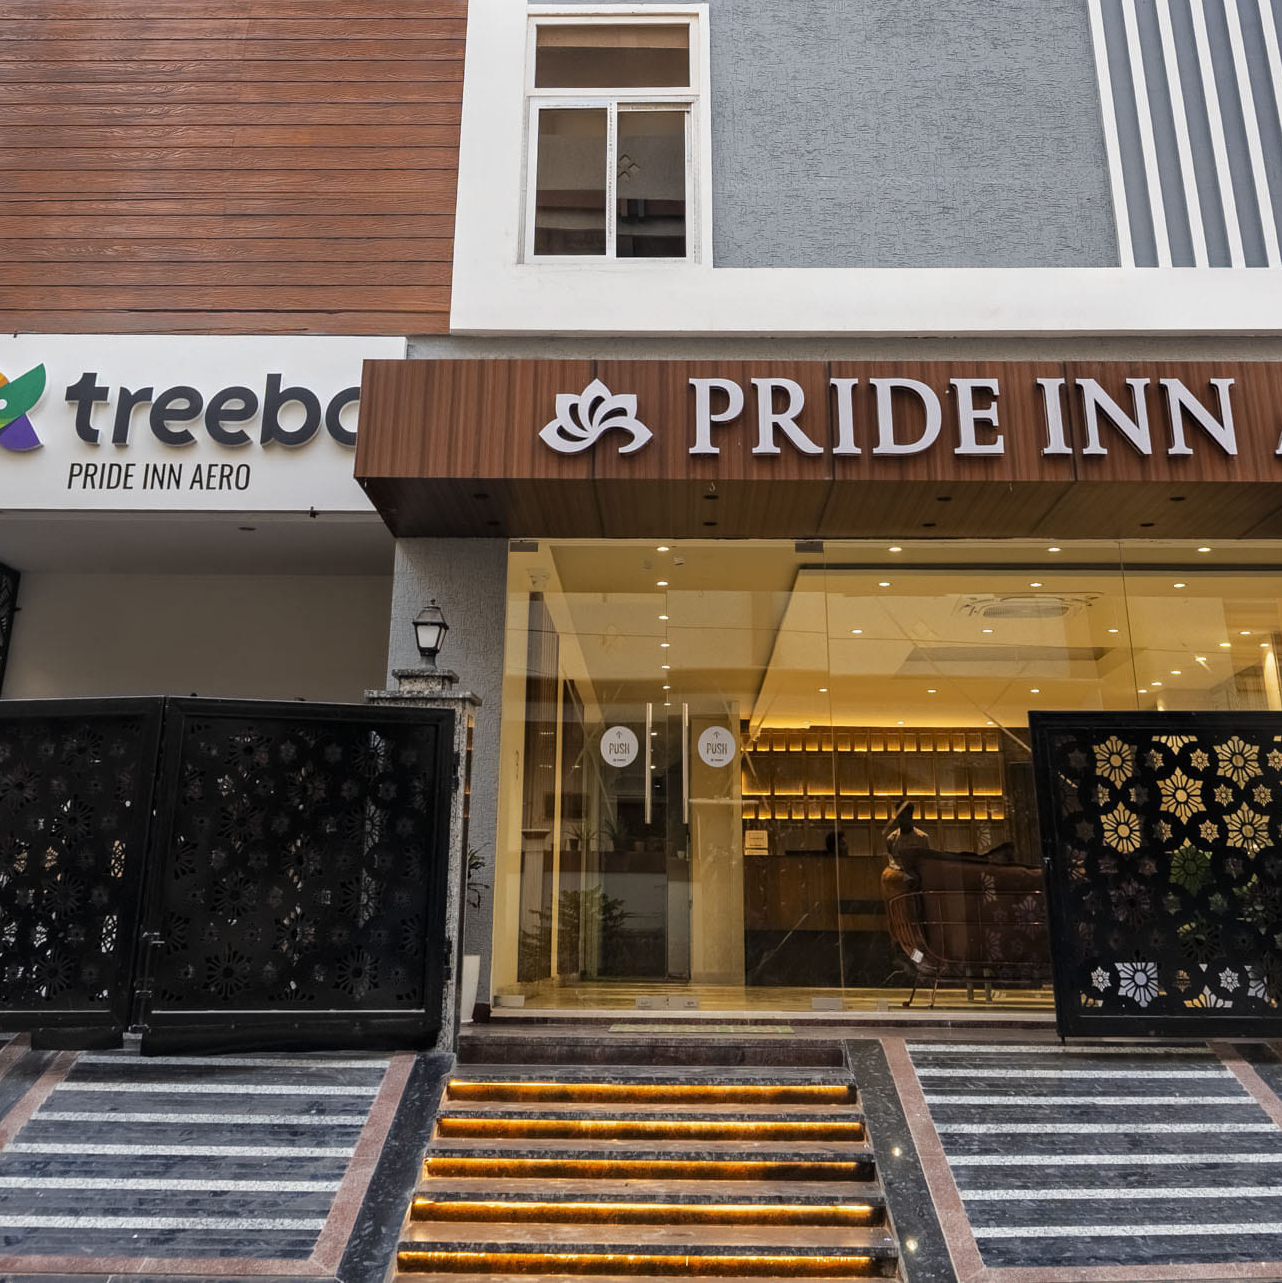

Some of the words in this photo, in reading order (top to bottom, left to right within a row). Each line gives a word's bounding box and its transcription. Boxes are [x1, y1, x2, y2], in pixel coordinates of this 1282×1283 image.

[688, 377, 1005, 456] PRIDE
[1036, 377, 1237, 456] INN
[67, 462, 135, 490] PRIDE
[142, 463, 182, 490] INN
[190, 464, 251, 491] AERO
[608, 742, 630, 755] PUSH
[706, 742, 728, 755] PUSH
